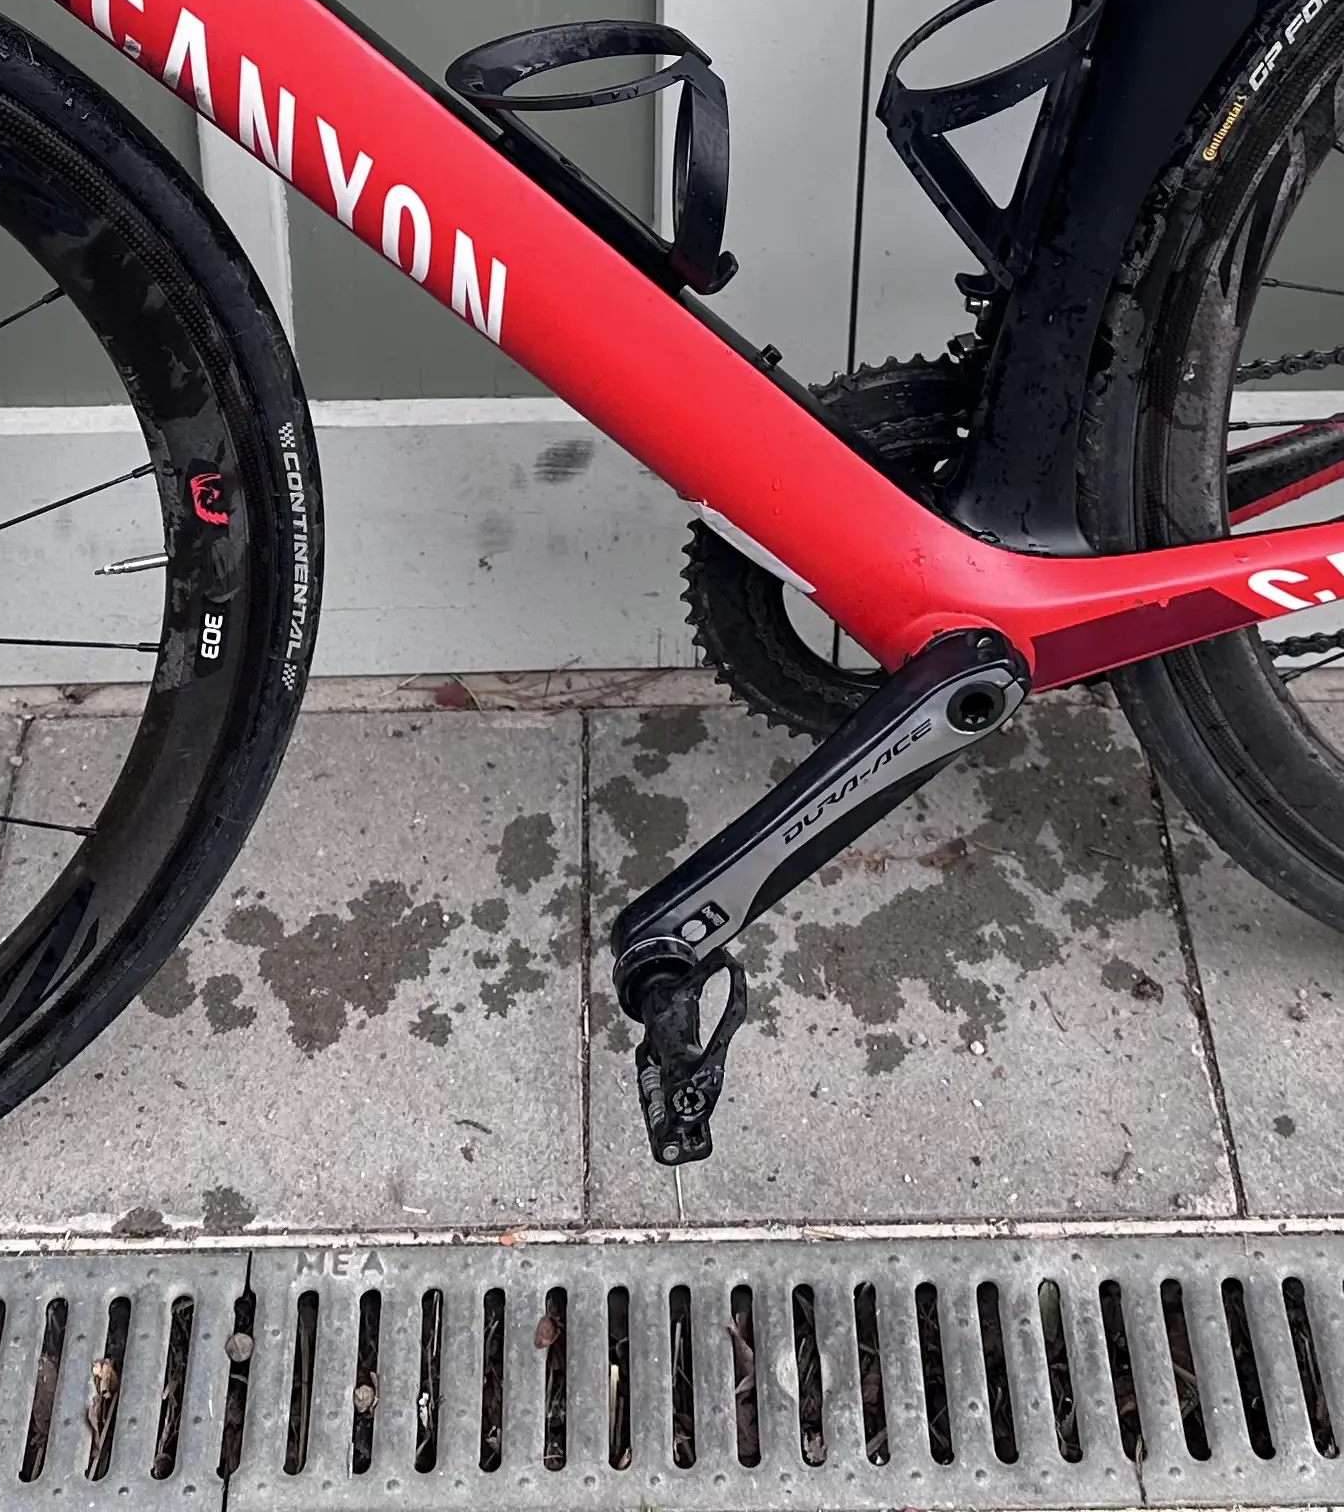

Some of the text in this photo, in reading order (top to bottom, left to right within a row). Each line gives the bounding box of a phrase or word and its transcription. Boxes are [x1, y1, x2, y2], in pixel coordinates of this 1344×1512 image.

[1201, 103, 1244, 162] Continental
[1248, 40, 1284, 92] GP
[282, 451, 309, 660] CONTINENTAL
[200, 612, 224, 660] 303
[781, 717, 933, 846] DURA-ACE
[296, 1250, 386, 1277] MEA
